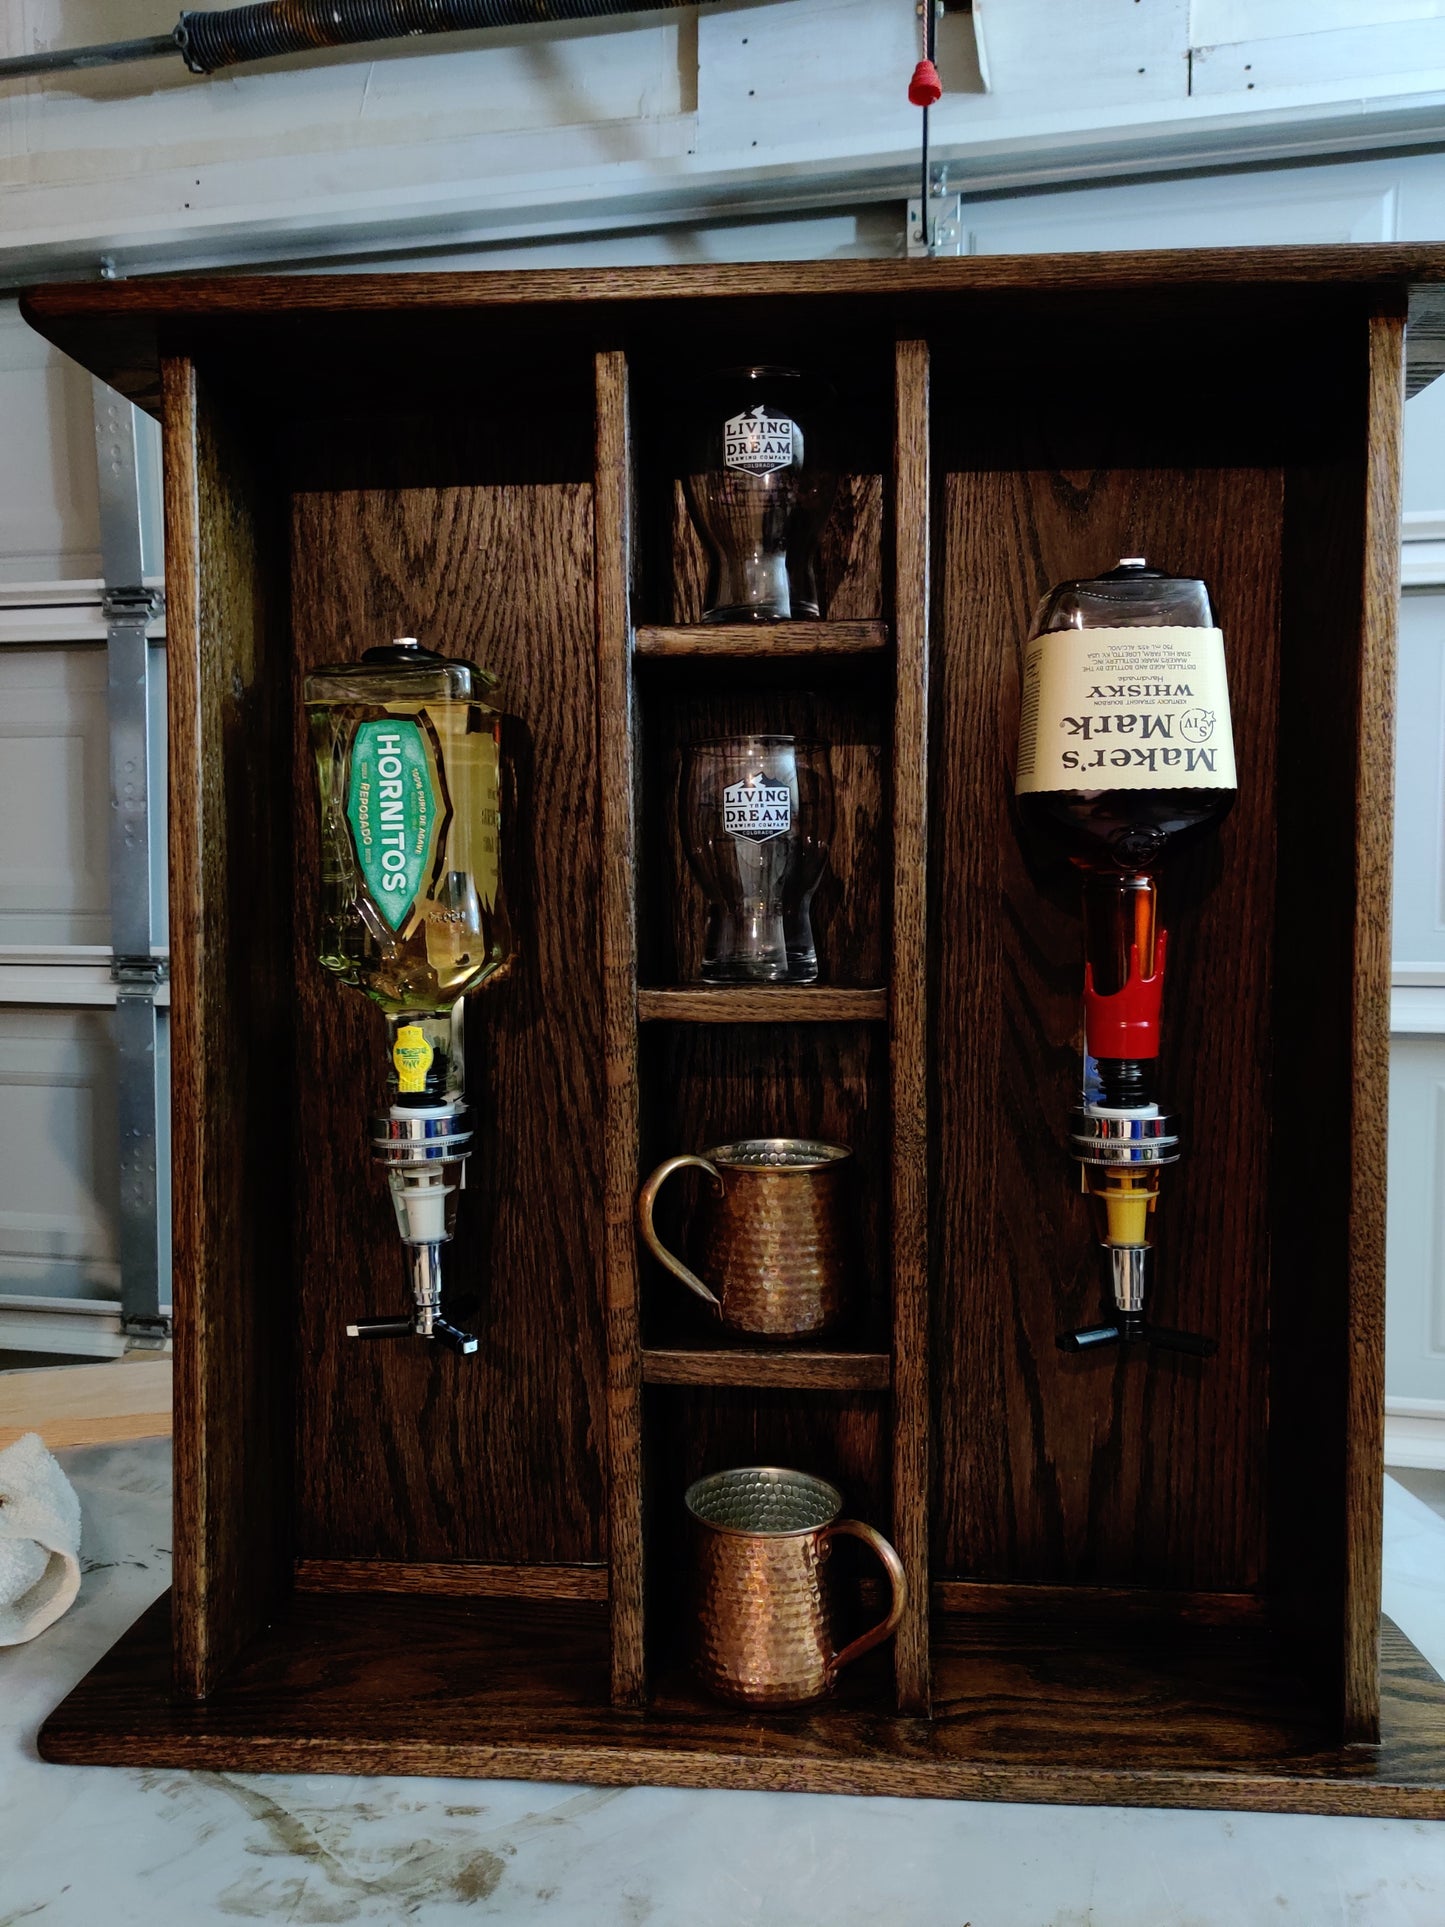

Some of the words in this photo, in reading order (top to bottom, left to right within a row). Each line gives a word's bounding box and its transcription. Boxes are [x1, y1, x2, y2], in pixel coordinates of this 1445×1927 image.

[726, 422, 790, 436] LIVING
[726, 441, 791, 455] DREAM
[1085, 684, 1194, 698] WHISKY
[1184, 717, 1199, 728] IV
[1199, 727, 1208, 737] S
[1061, 748, 1218, 772] Maker's
[412, 768, 423, 789] 100%
[417, 791, 427, 813] PURO
[726, 790, 788, 803] LIVING
[358, 783, 372, 845] REPOSADO
[377, 734, 407, 893] HORNITOS
[419, 815, 427, 826] DE
[726, 810, 788, 822] DREAM
[415, 827, 426, 855] AGAVE
